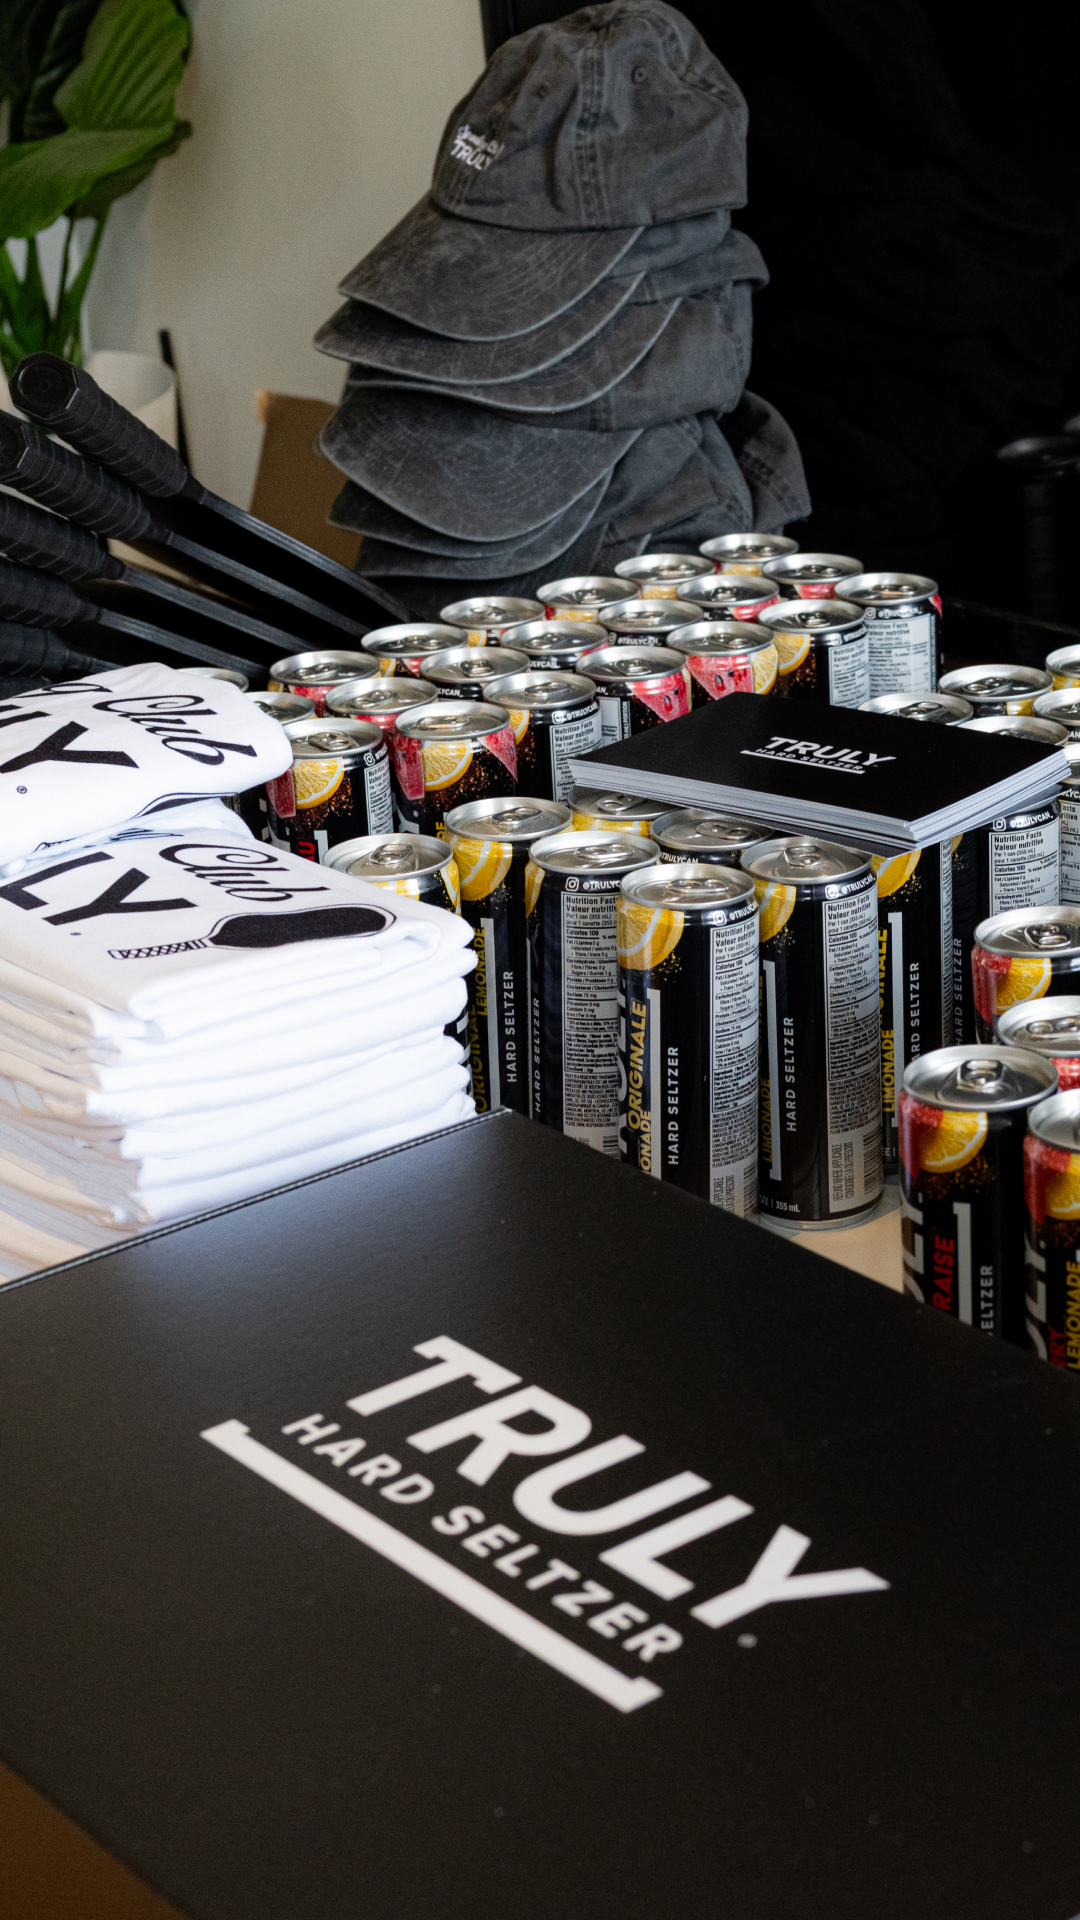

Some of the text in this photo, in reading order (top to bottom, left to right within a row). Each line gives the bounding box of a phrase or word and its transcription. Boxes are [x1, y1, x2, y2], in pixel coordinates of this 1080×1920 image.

[92, 694, 258, 766] Club
[554, 725, 580, 734] Nutrition
[555, 734, 574, 742] Valeur
[765, 736, 896, 766] TRULY
[755, 748, 863, 771] HARD SELTZER
[994, 830, 1042, 843] Nutrition Facts
[994, 839, 1044, 850] Valeur nutritive
[159, 844, 331, 902] Club
[566, 896, 598, 904] Nutrition
[716, 927, 742, 938] Nutrition
[828, 895, 869, 912] Nutrition Facts
[828, 910, 850, 920] Valeur
[716, 937, 736, 947] Valeur
[716, 962, 735, 971] Calories
[829, 935, 848, 943] Calories
[474, 927, 488, 1016] LEMONADE
[954, 937, 962, 1001] SELTZER
[503, 971, 517, 1083] HARD SELTZER
[910, 962, 920, 1061] ARD SELTZER
[628, 1000, 646, 1130] ORIGINALE
[784, 1017, 796, 1132] HARD SELTZER
[882, 1029, 895, 1112] LIMONADE
[668, 1047, 679, 1165] HARD SELTZER
[761, 1078, 772, 1163] LIMONADE
[776, 1201, 800, 1212] 355 mL
[980, 1265, 994, 1336] ELTZER
[1066, 1260, 1080, 1370] LEMONADE
[346, 1335, 891, 1629] TRULY
[281, 1414, 684, 1662] HARD SELTZER
